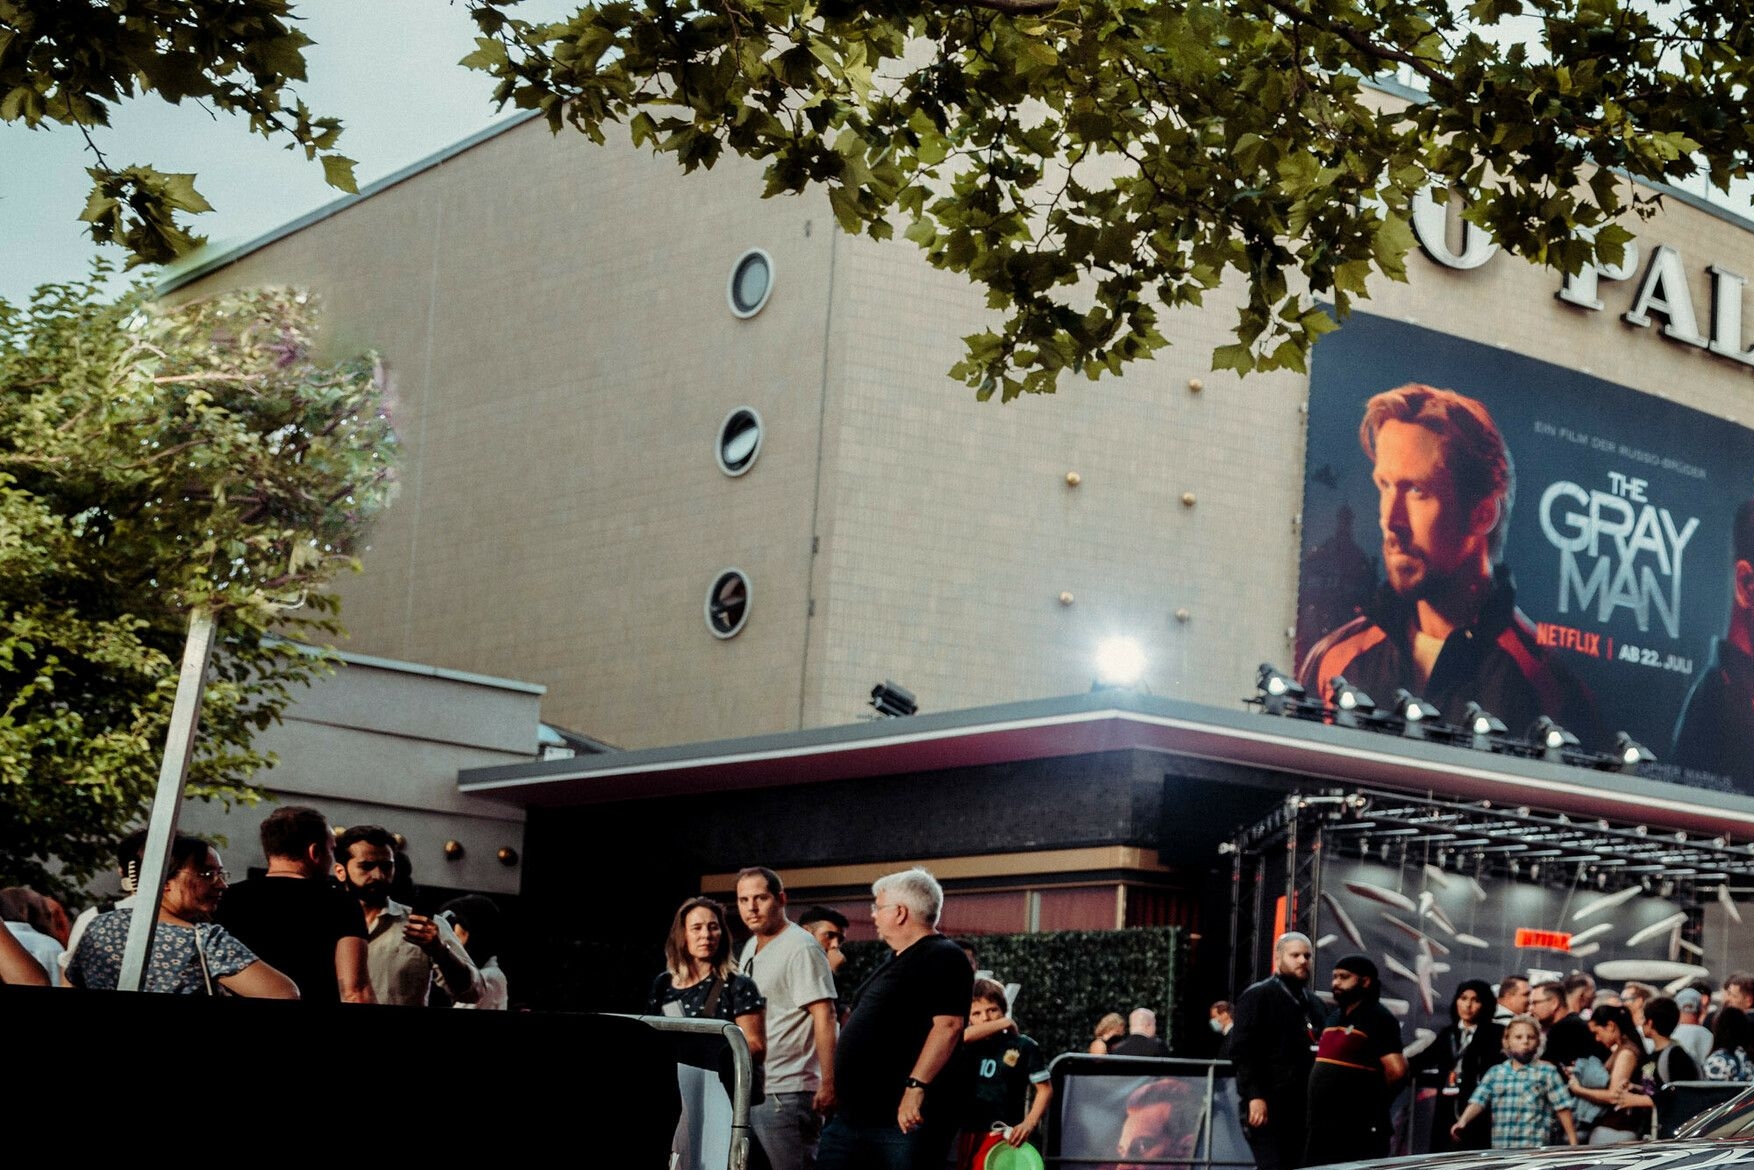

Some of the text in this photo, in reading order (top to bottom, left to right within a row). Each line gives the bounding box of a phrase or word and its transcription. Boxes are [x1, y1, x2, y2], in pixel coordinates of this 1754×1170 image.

[1558, 427, 1589, 445] FILM
[1607, 470, 1649, 503] THE
[1539, 480, 1700, 576] GRAY
[1558, 549, 1684, 640] MAN
[1536, 621, 1600, 658] NETFLIX
[1618, 643, 1640, 663] AB
[1663, 654, 1693, 675] JULI
[980, 1058, 997, 1079] 10
